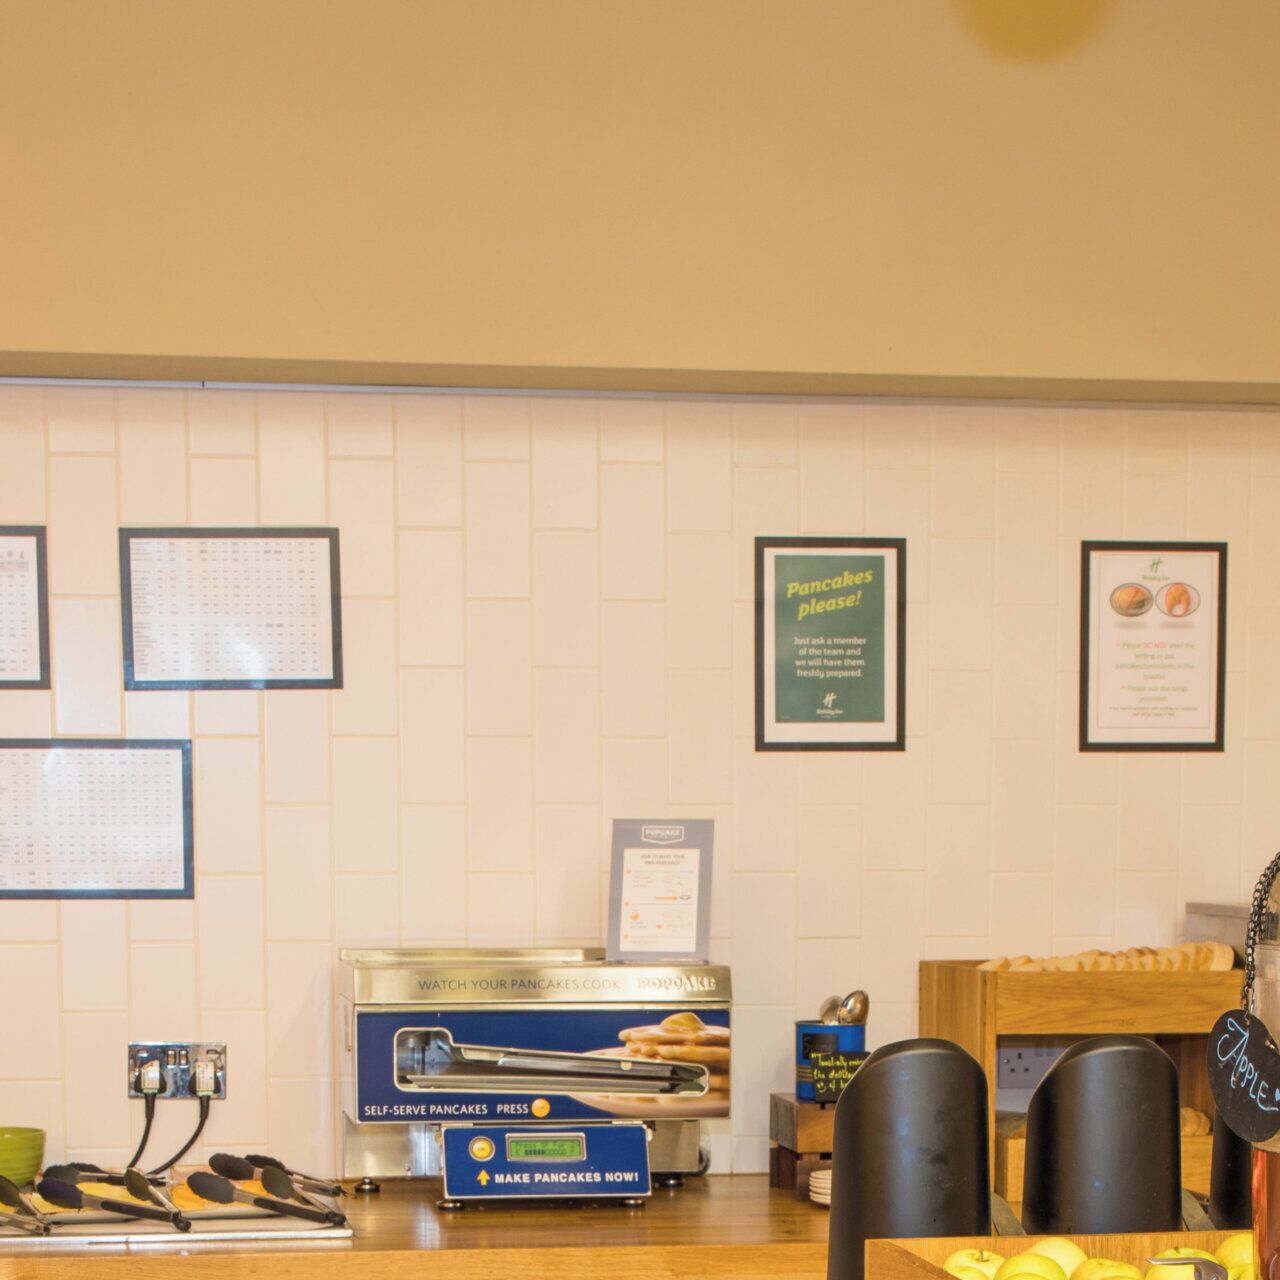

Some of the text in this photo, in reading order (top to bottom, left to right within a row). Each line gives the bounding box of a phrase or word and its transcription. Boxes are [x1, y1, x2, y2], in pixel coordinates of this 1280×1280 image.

[786, 570, 873, 598] Pancakes
[798, 590, 862, 621] please!
[794, 637, 810, 645] Just
[811, 637, 825, 645] ask
[833, 637, 867, 645] member
[799, 647, 861, 656] of the team and
[807, 658, 822, 666] will
[823, 658, 842, 666] have
[843, 658, 865, 666] them
[797, 669, 863, 679] freshly prepared.
[418, 978, 622, 991] WATCH YOUR PANCAKES COOK
[637, 975, 717, 992] POPCAKE
[364, 1103, 529, 1116] SELF-SERVE PANCAKES PRESS
[494, 1172, 639, 1183] MAKE PANCAKES NOW!
